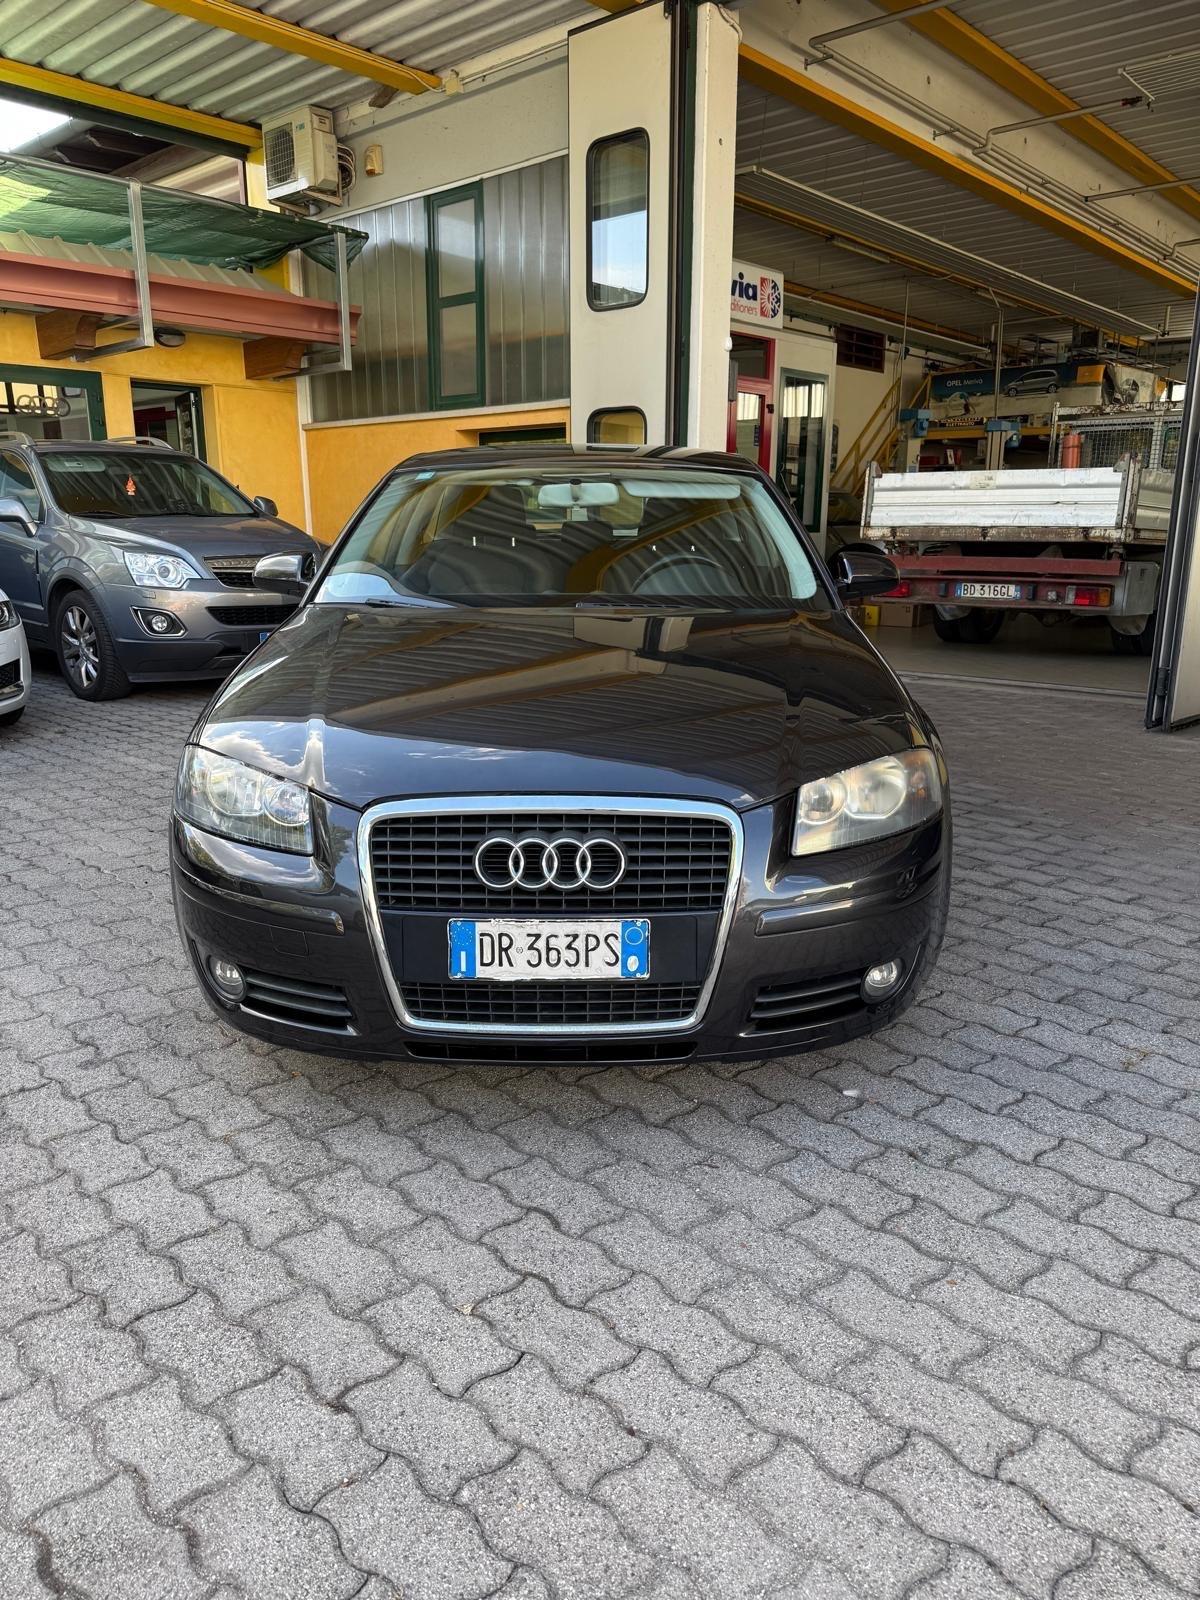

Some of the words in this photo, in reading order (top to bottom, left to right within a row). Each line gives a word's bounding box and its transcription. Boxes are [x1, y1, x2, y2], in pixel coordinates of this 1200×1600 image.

[946, 379, 962, 387] OPEL
[963, 584, 976, 596] BD
[979, 584, 1013, 597] 316GL
[479, 933, 514, 967] DR
[526, 933, 620, 967] 363PS
